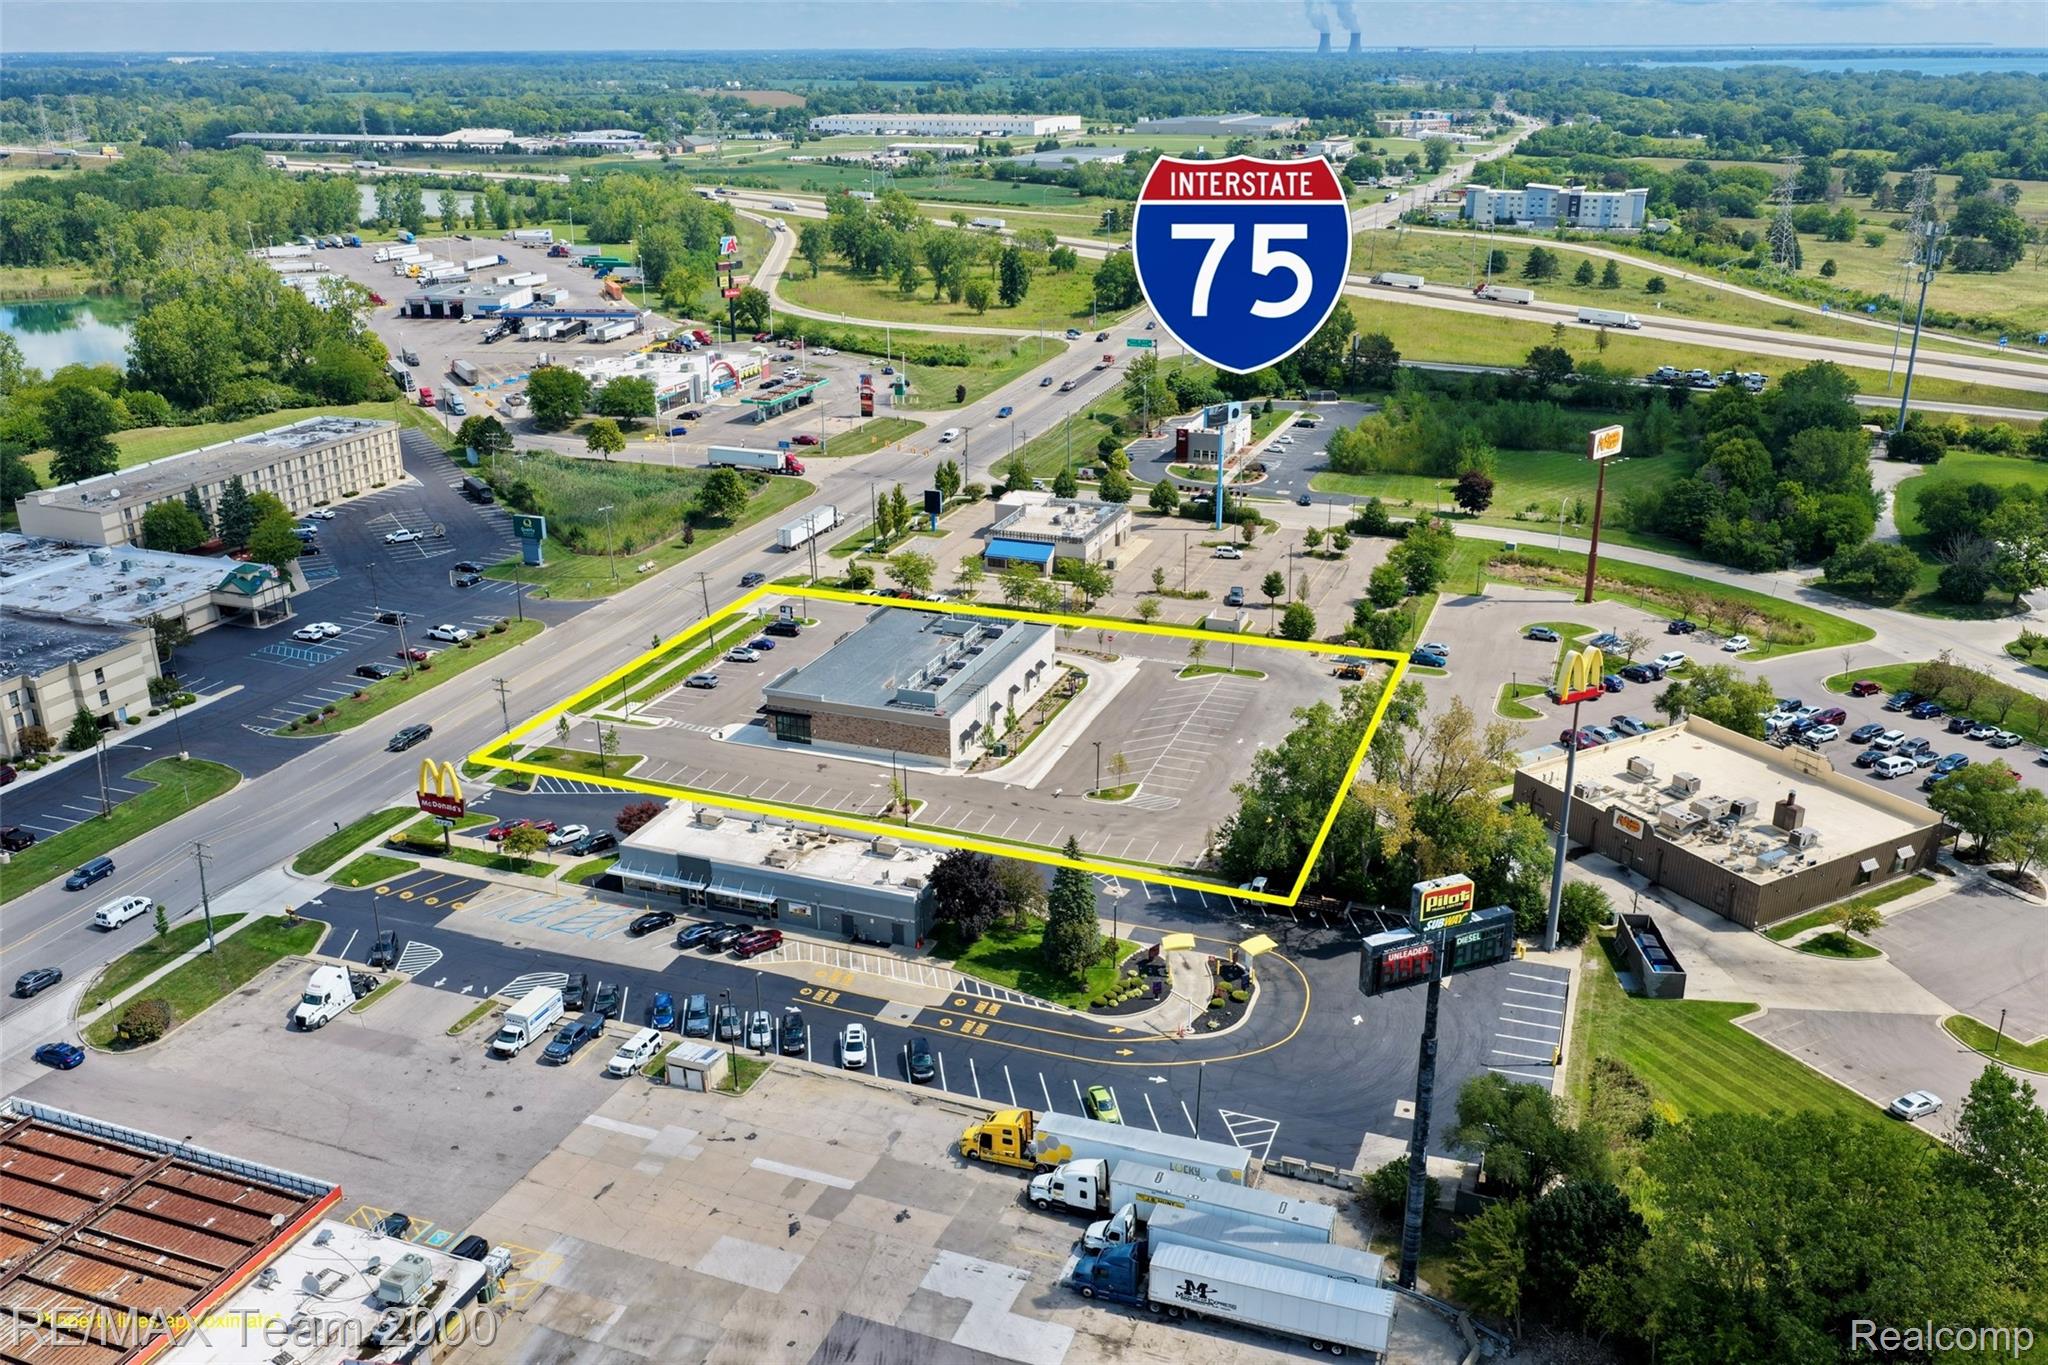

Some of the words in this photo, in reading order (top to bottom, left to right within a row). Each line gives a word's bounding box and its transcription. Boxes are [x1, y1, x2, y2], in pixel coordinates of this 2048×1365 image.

[720, 236, 737, 254] TA
[421, 800, 462, 813] McDonald's
[1426, 890, 1470, 912] Pilot
[1423, 911, 1468, 932] SUBWAY
[1456, 932, 1481, 946] DIESEL
[1388, 946, 1429, 962] UNLEADED
